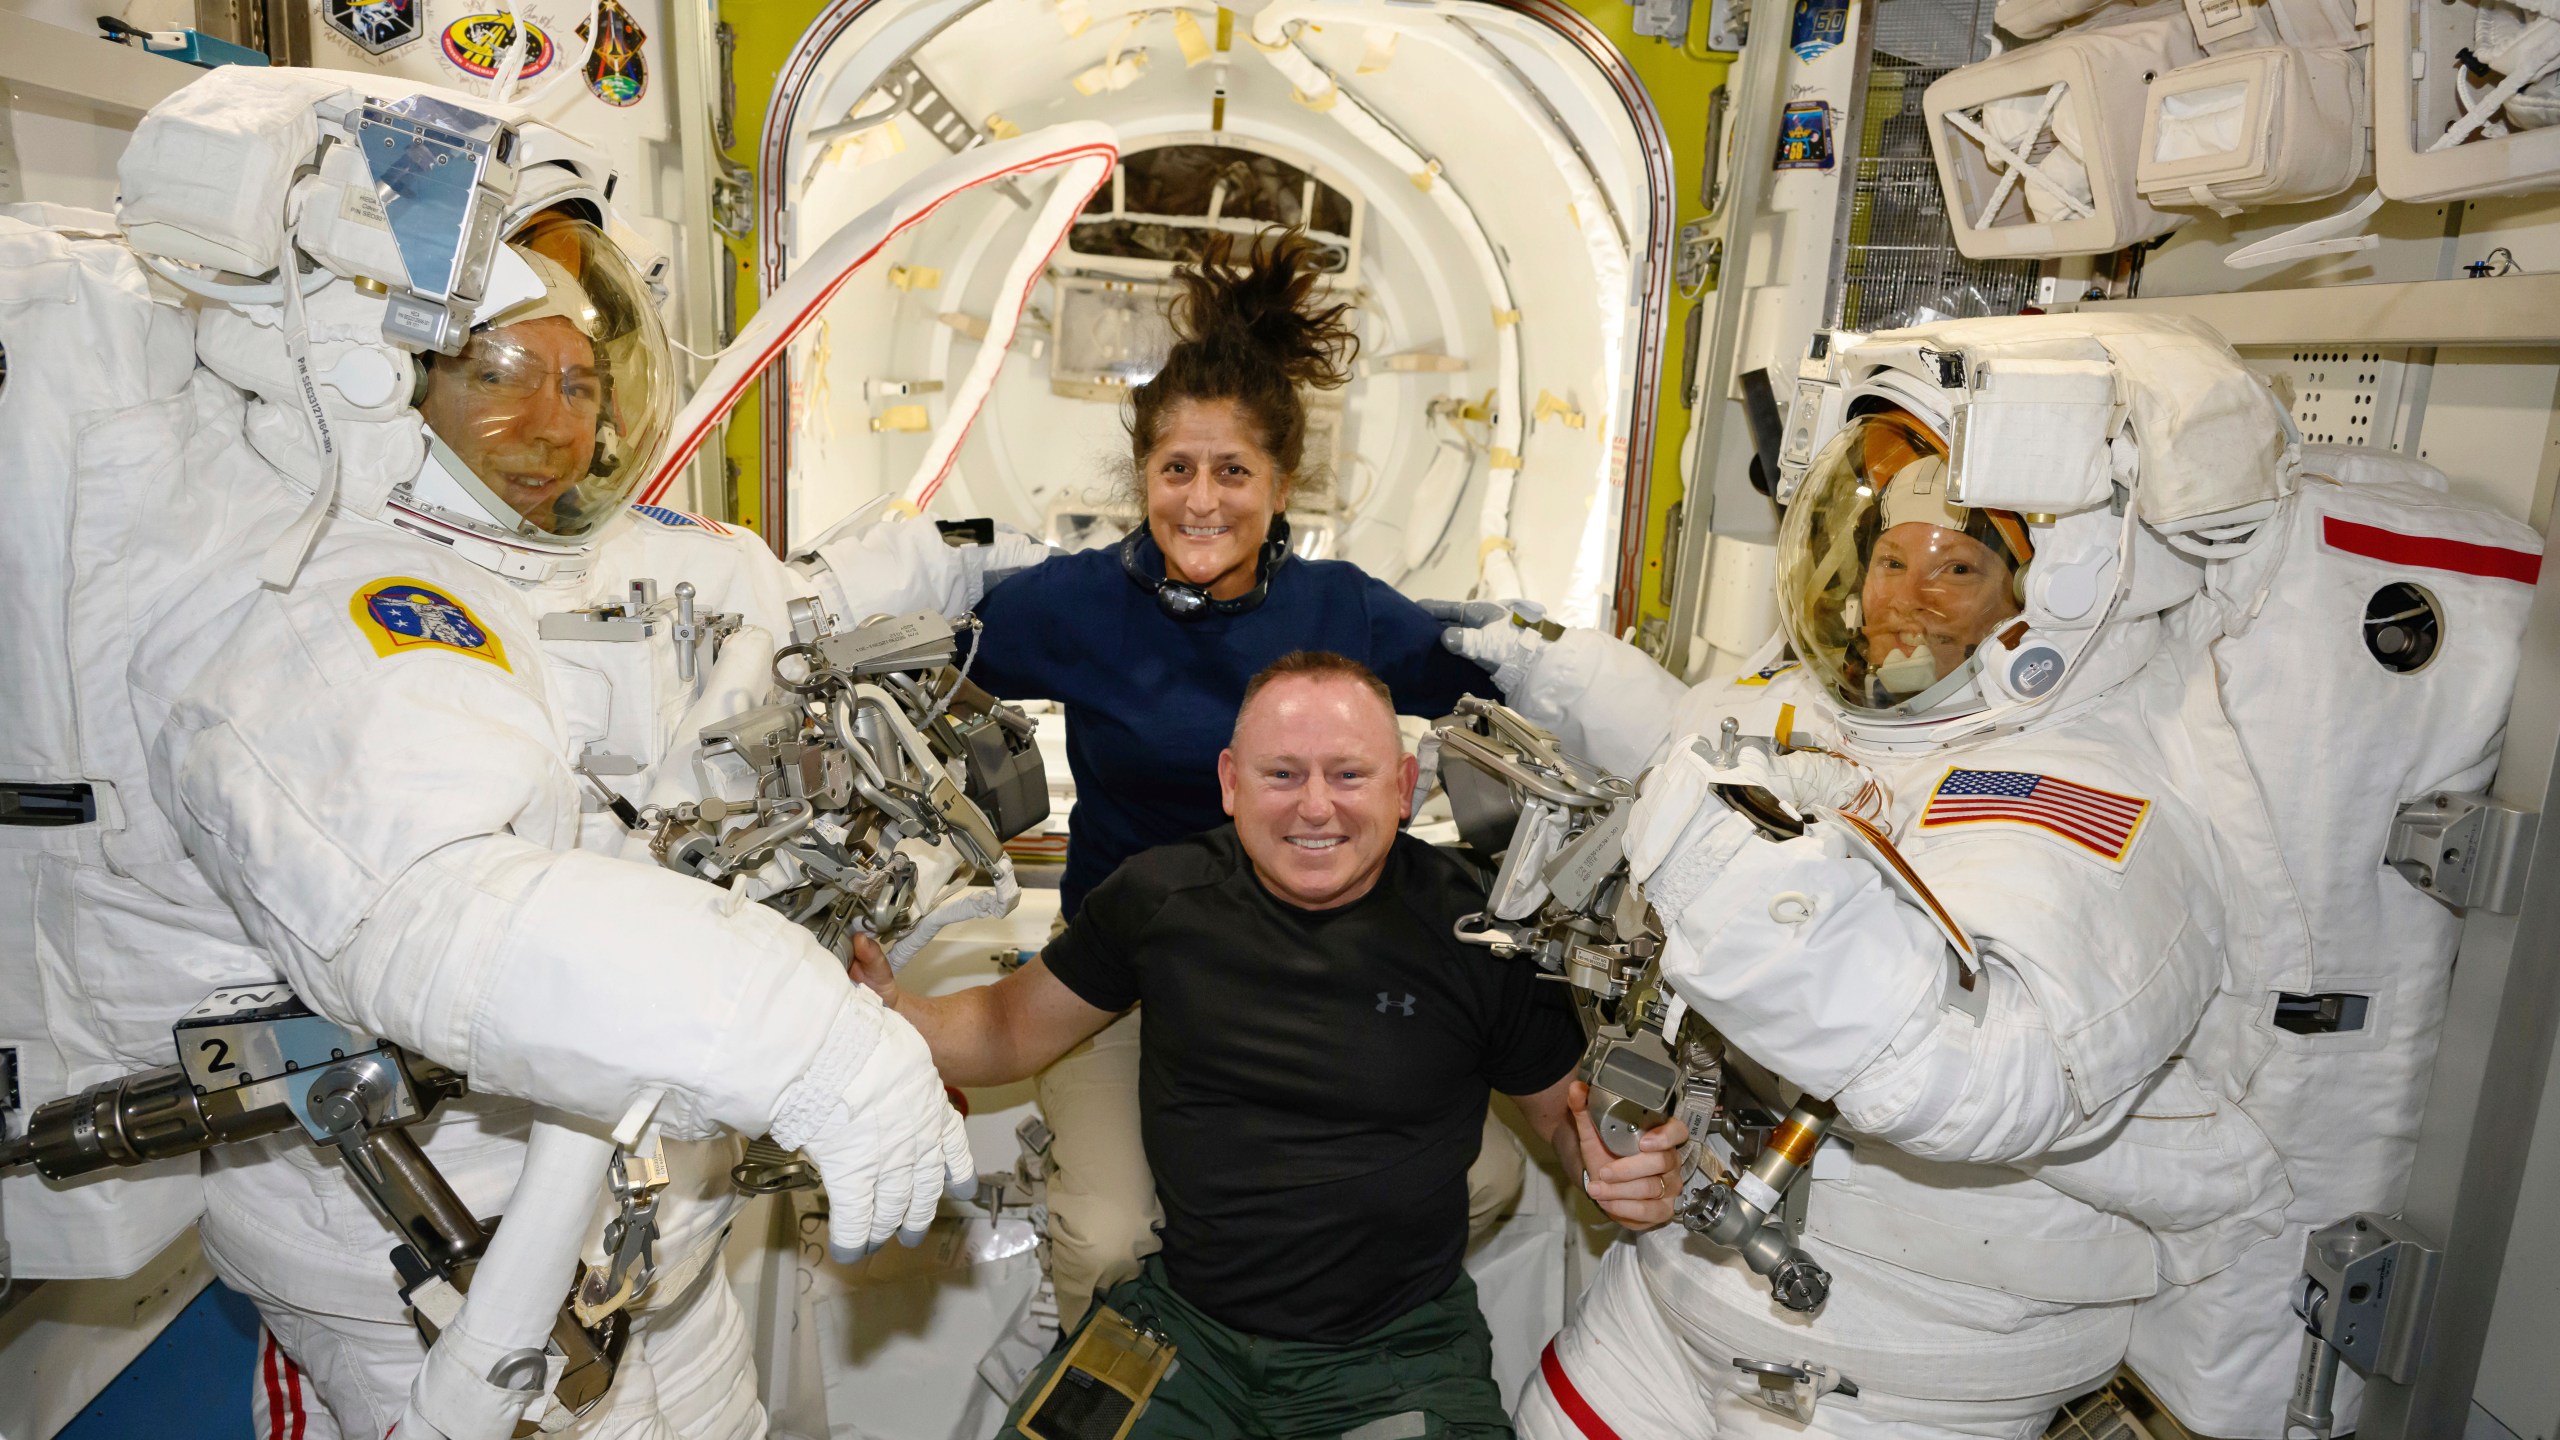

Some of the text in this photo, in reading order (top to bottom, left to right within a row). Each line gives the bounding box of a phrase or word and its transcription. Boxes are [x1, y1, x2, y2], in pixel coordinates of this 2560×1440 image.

[1817, 11, 1843, 32] 60
[383, 34, 409, 49] PATRICK
[1789, 143, 1804, 160] 59
[297, 356, 333, 455] P/N SEG33127464-302
[229, 990, 276, 1005] 2
[200, 1038, 236, 1074] 2
